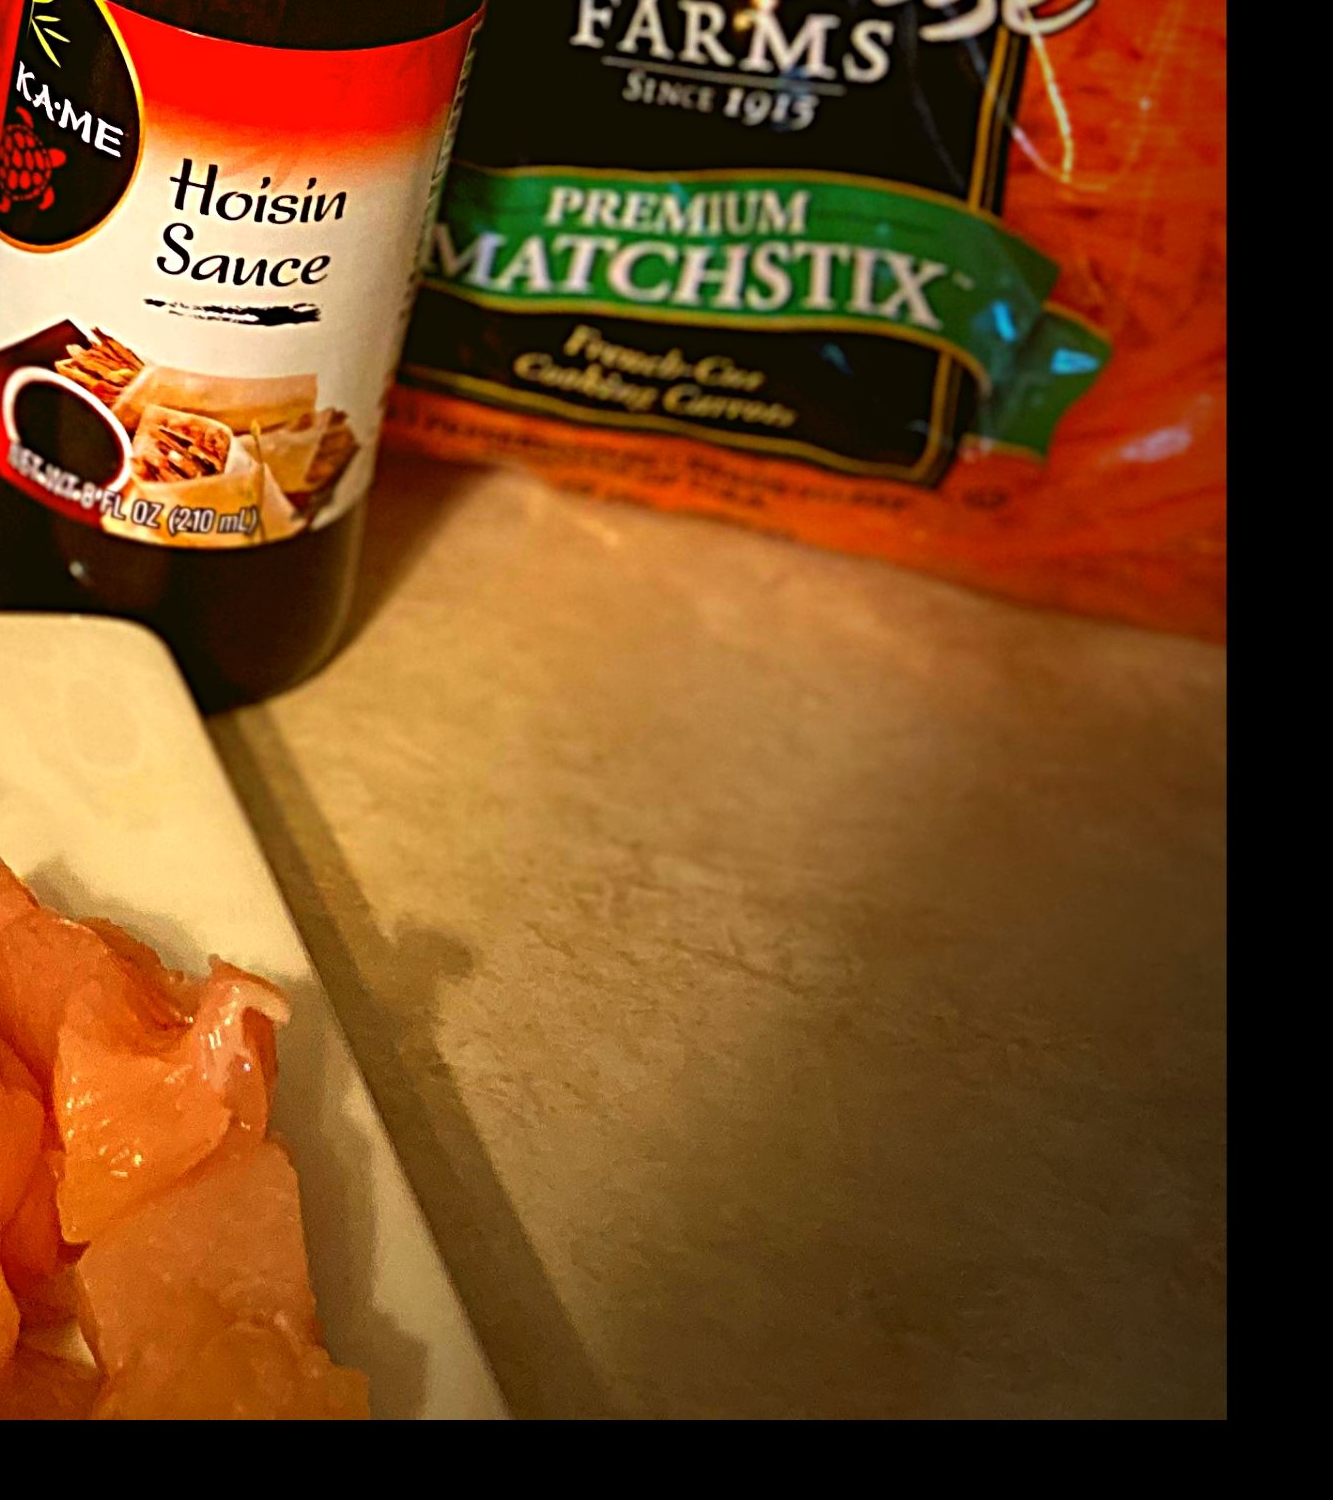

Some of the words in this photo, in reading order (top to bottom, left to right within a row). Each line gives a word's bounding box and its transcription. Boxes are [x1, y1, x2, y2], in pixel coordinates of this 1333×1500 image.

[723, 91, 820, 131] 1915
[170, 159, 348, 225] Hoisin
[546, 186, 809, 236] PREMIUM
[156, 222, 331, 287] Sauce
[430, 224, 944, 329] MATCHSTIX
[134, 500, 165, 529] OZ
[168, 506, 214, 537] (210
